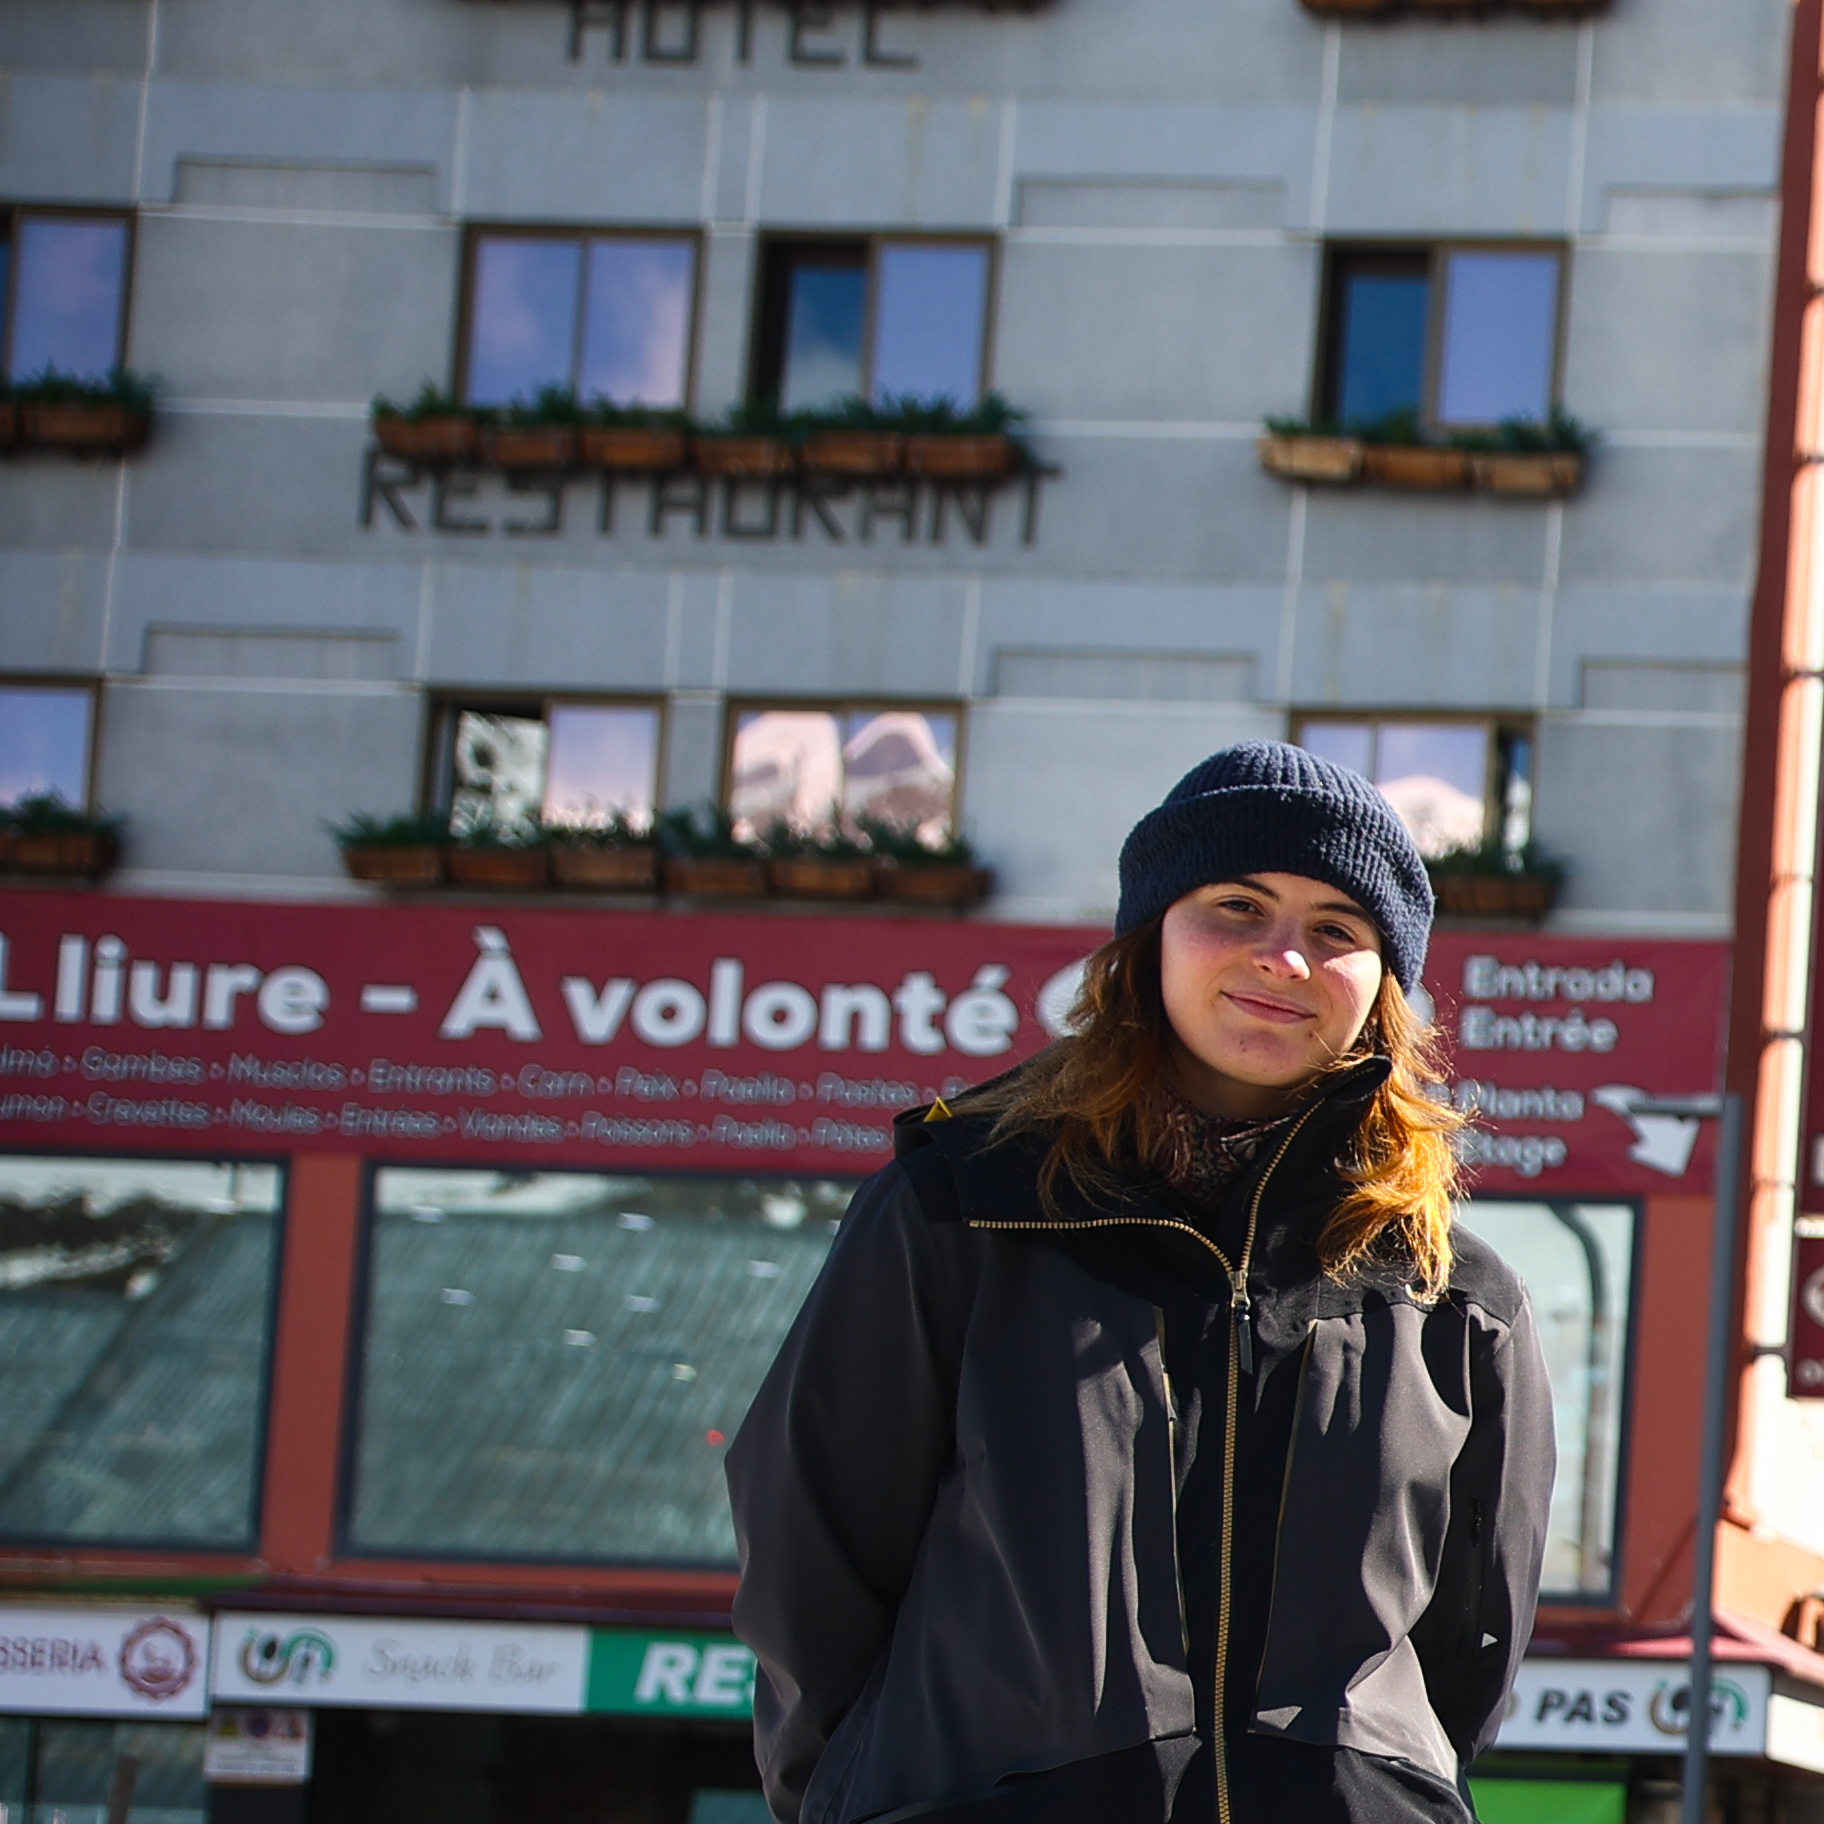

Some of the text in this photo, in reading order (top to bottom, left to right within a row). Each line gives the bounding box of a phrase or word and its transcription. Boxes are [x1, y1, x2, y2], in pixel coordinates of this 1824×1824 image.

[358, 447, 1066, 546] RESTAURANT
[437, 925, 544, 1042] À
[561, 956, 1019, 1056] volonté
[1463, 954, 1655, 1004] Entrada
[1460, 1003, 1620, 1053] Entrée
[634, 1641, 757, 1706] RE
[1535, 1687, 1631, 1727] PAS
